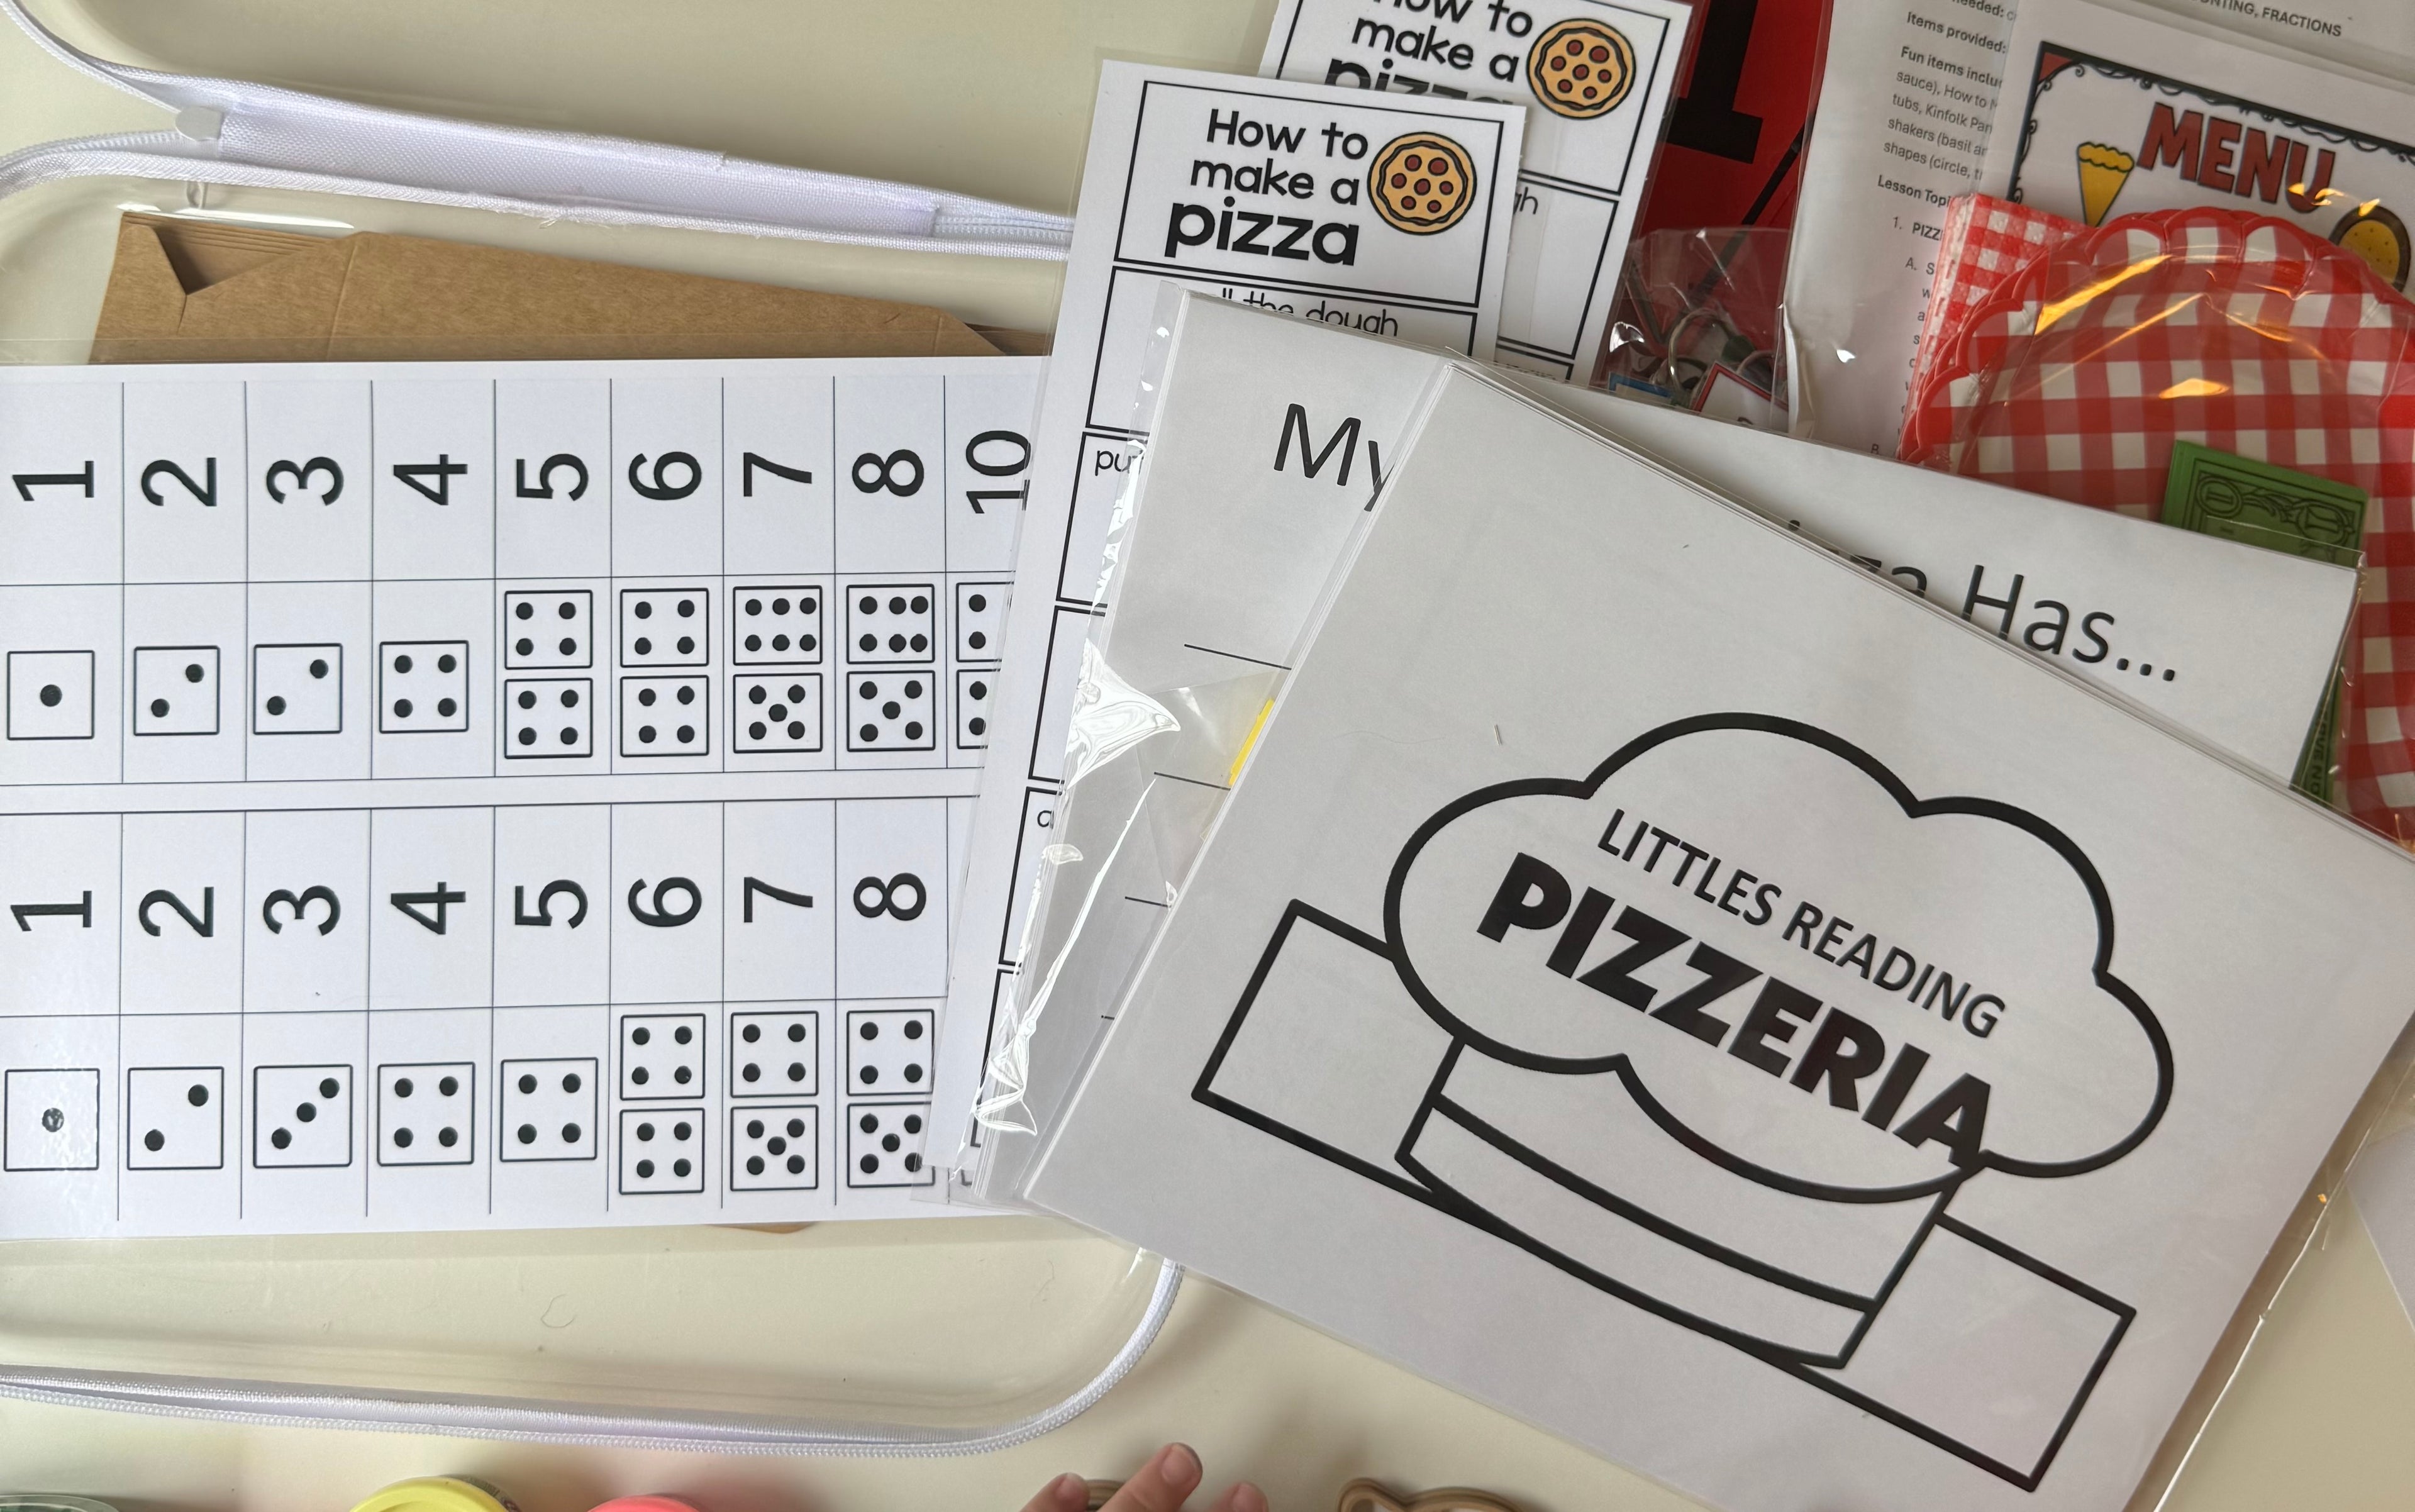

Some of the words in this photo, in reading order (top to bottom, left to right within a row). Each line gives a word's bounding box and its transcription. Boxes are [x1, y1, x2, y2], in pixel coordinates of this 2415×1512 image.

[1487, 0, 1533, 38] to
[1907, 11, 1944, 33] Items
[1946, 27, 2006, 54] provided:
[2262, 7, 2341, 36] FRACTIONS
[1352, 18, 1474, 70] make
[1489, 54, 1519, 83] a
[1901, 46, 1924, 64] Fun
[1927, 54, 1963, 76] items
[1892, 94, 1922, 114] tubs,
[1925, 104, 1968, 127] Kinfolk
[1896, 71, 1940, 96] sauce),
[1944, 84, 1972, 103] How
[1975, 95, 1987, 108] to
[1206, 109, 1306, 153] How
[1321, 122, 1368, 160] to
[1888, 118, 1935, 142] shakers
[1937, 132, 1972, 153] (basil
[2136, 102, 2336, 213] MENU
[1191, 158, 1314, 199] make
[1330, 178, 1360, 206] a
[1884, 142, 1927, 165] shapes
[1929, 155, 1970, 179] (circle,
[1877, 175, 1922, 199] Lesson
[1164, 196, 1360, 266] pizza
[1893, 216, 1902, 230] 1.
[1905, 257, 1917, 270] A.
[13, 461, 94, 501] 1
[266, 457, 343, 506] 3
[394, 454, 467, 505] 4
[516, 454, 588, 501] 5
[629, 452, 702, 500] 6
[743, 452, 812, 497] 7
[852, 449, 924, 497] 8
[966, 430, 1031, 514] 10
[1274, 403, 1396, 512] My
[141, 458, 216, 506] 2
[1961, 565, 2175, 682] Has...
[11, 891, 91, 931] 1
[139, 887, 213, 937] 2
[263, 886, 340, 936] 3
[391, 882, 465, 935] 4
[515, 880, 587, 928] 5
[628, 877, 702, 927] 6
[744, 877, 813, 923] 7
[853, 873, 926, 921] 8
[1598, 809, 1782, 926] LITTLES
[1782, 901, 2006, 1039] READING
[1477, 852, 1992, 1168] PIZZERIA
